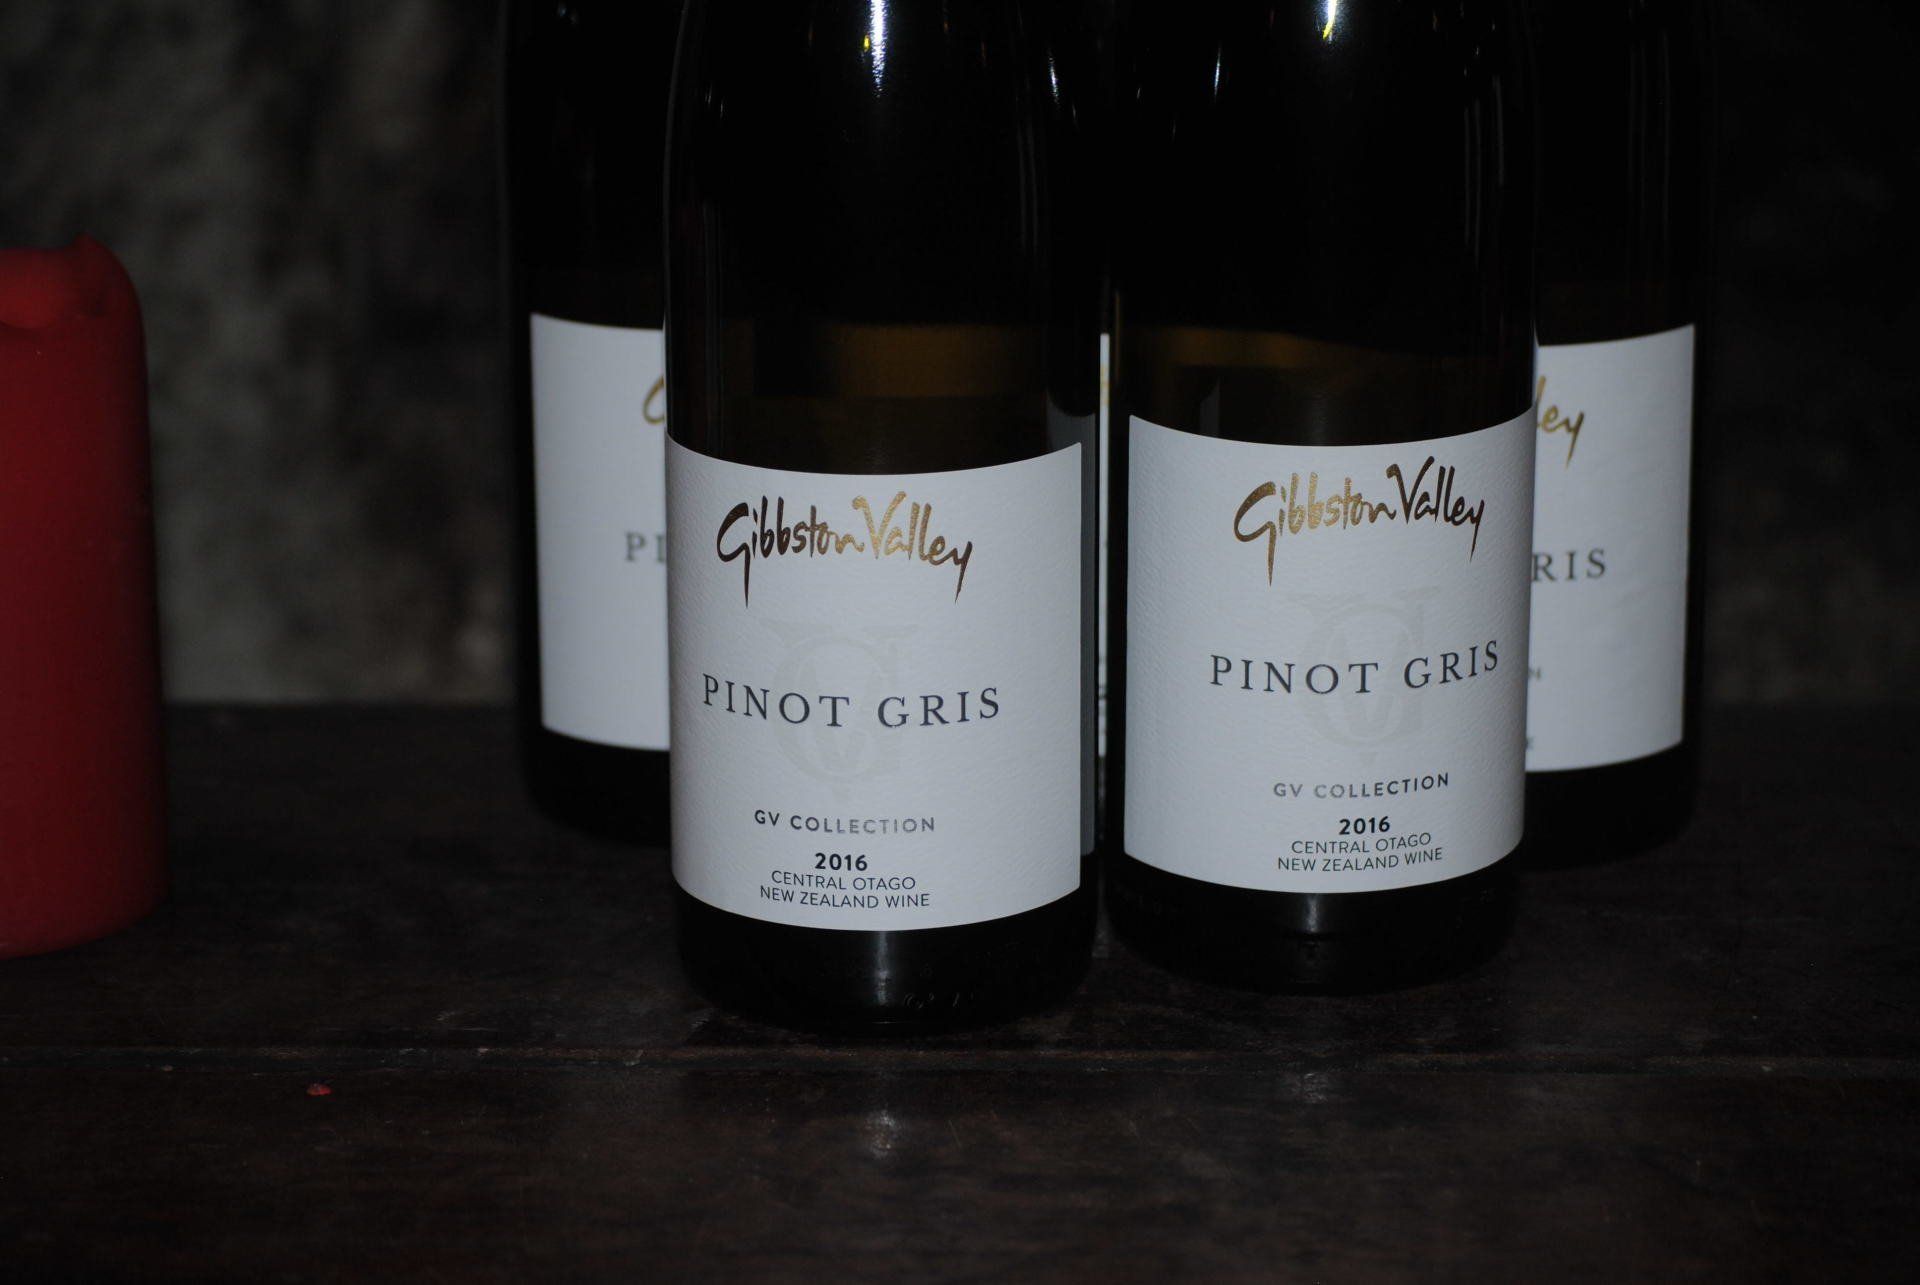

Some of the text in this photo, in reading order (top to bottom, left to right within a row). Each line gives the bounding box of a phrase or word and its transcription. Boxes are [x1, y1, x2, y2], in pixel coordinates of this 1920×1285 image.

[1233, 455, 1485, 588] Gibbston Valley
[716, 491, 973, 608] Gibbston Valley
[1532, 548, 1606, 582] RIS
[1210, 640, 1499, 695] PINOT GRIS
[702, 673, 1000, 728] PINOT GRIS
[1273, 772, 1449, 799] GV COLLECTION
[754, 809, 935, 834] GV COLLECTION
[1339, 816, 1391, 835] 2016
[1291, 832, 1432, 855] CENTRAL OTAGO
[815, 852, 868, 871] 2016
[1278, 847, 1443, 872] NEW ZEALAND WINE
[771, 870, 916, 891] CENTRAL OTAGO
[760, 885, 930, 909] NEW ZEALAND WINE
